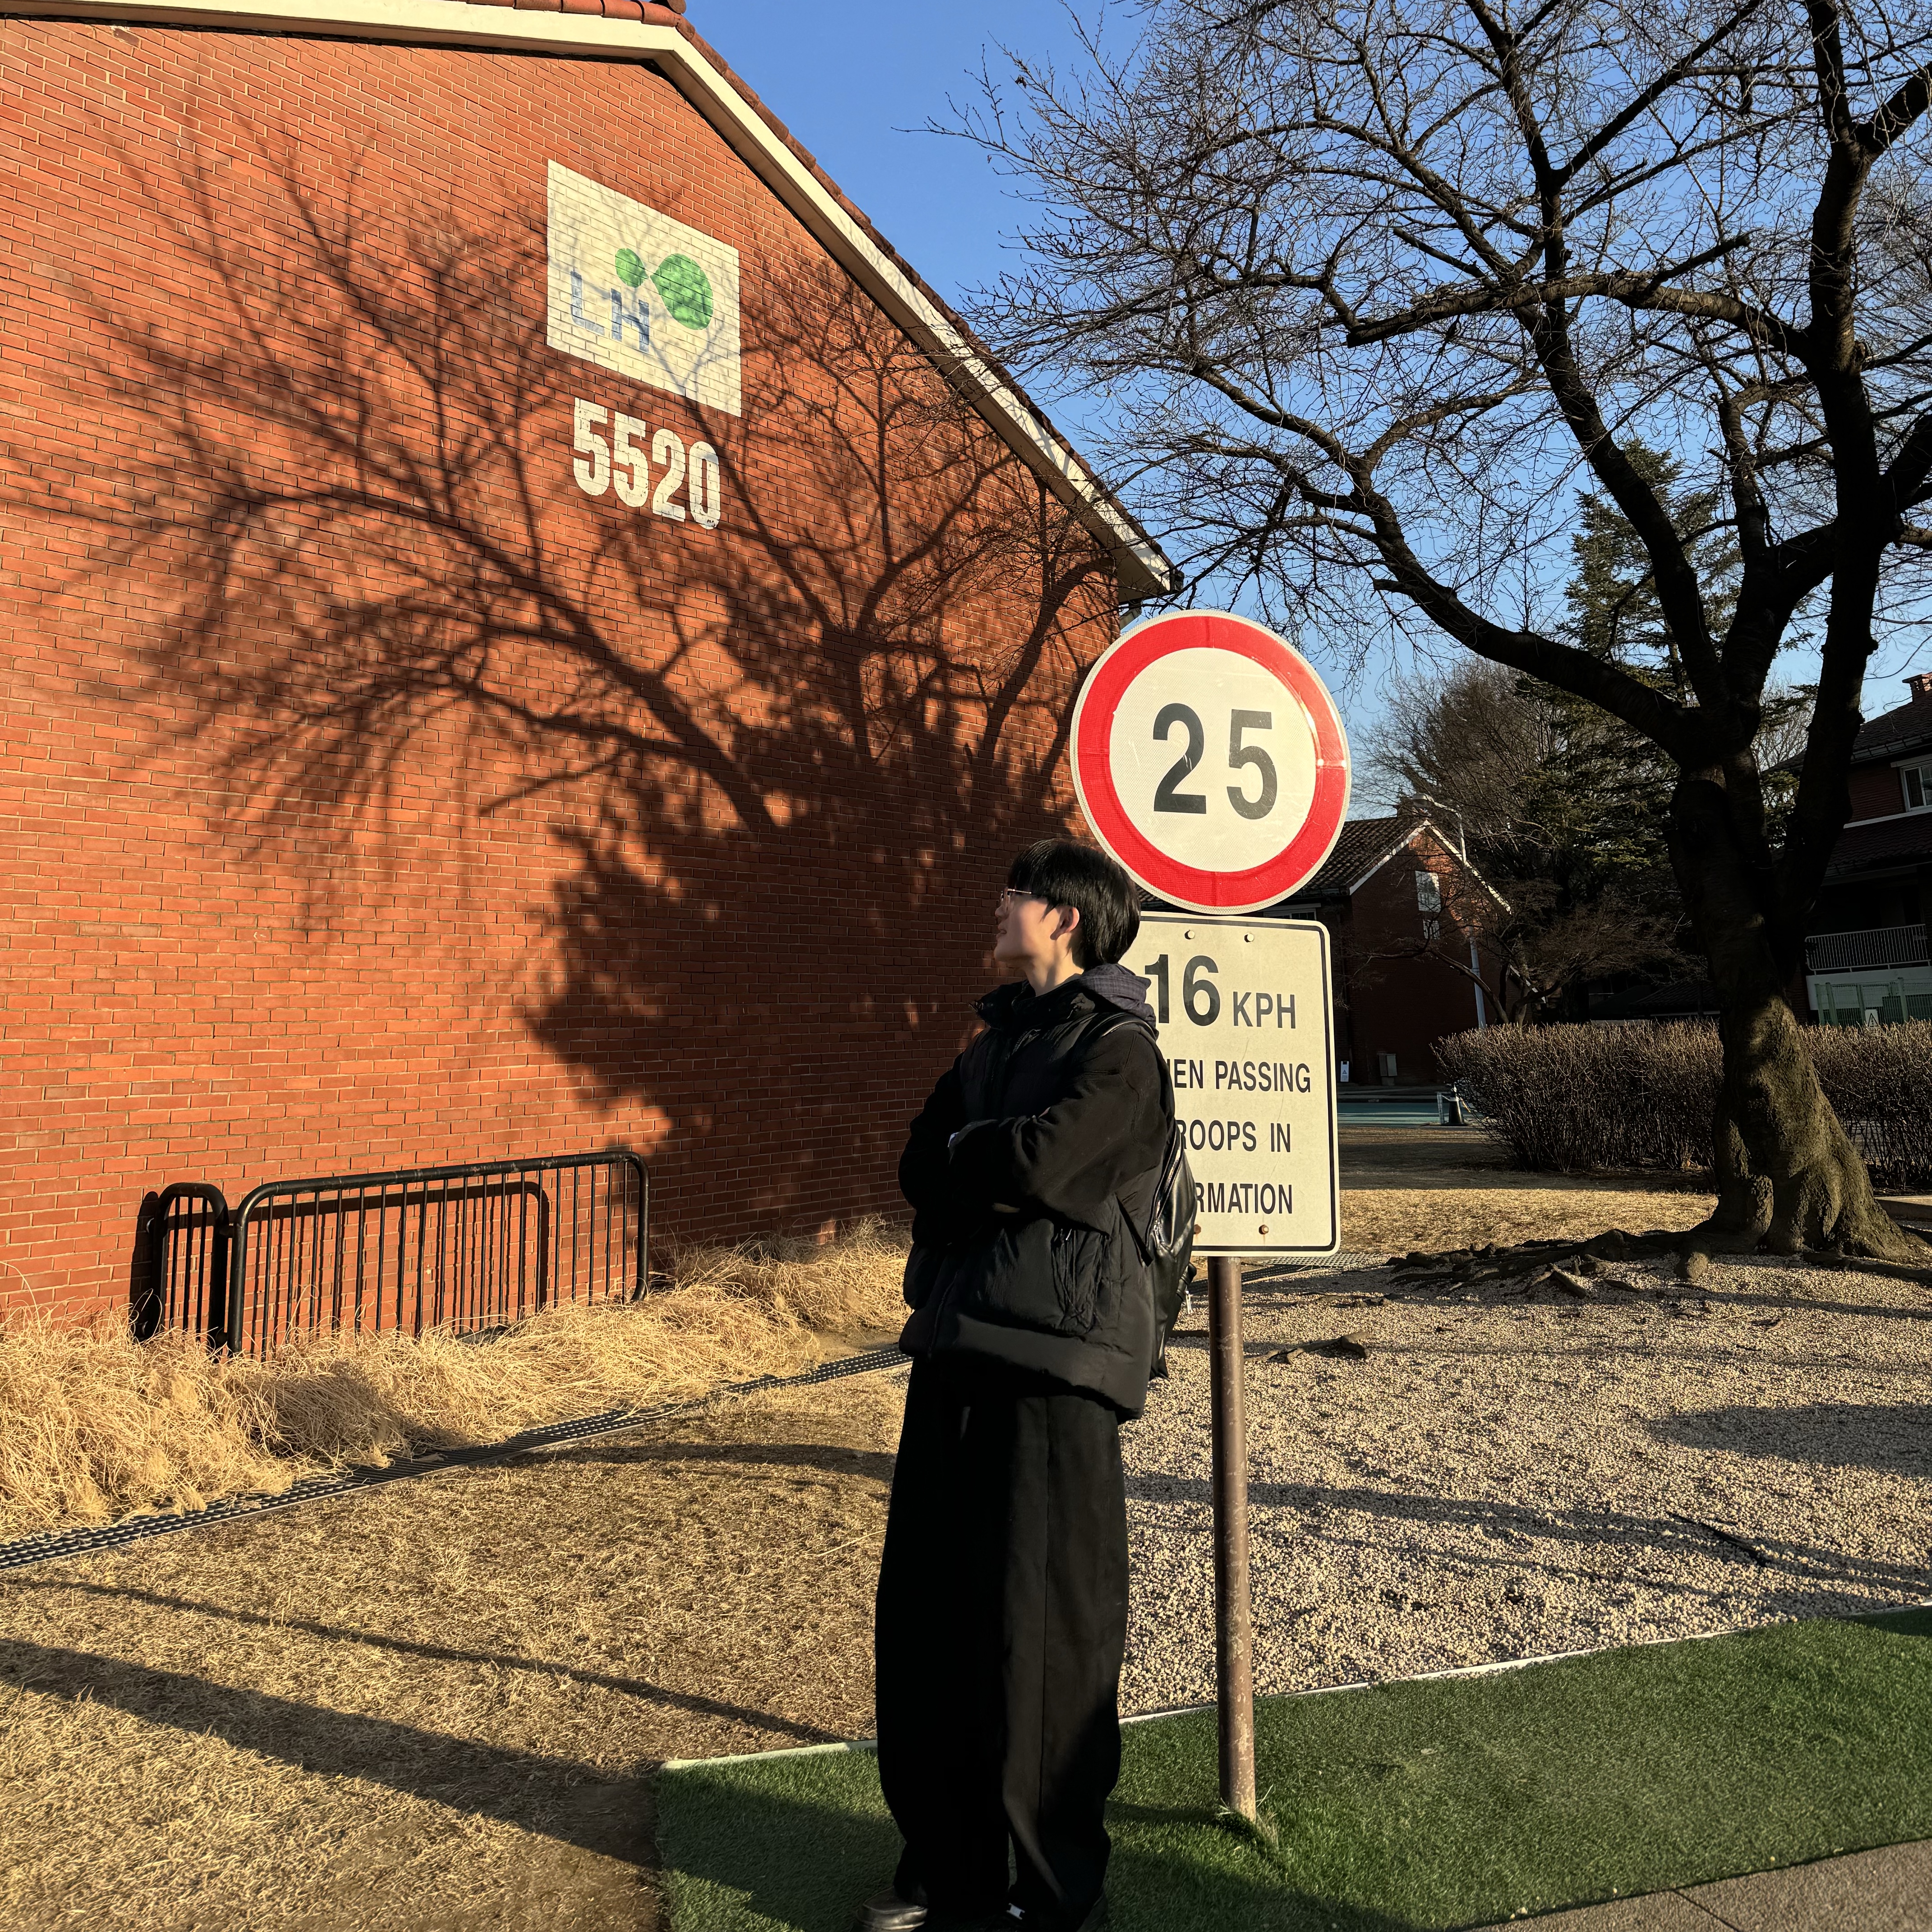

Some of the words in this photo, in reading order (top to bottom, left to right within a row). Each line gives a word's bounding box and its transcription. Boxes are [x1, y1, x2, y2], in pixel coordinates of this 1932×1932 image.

[570, 271, 650, 353] LH
[573, 397, 721, 530] 5520
[1153, 703, 1277, 820] 25
[1144, 954, 1221, 1026] 16
[1233, 991, 1296, 1029] KPH
[1167, 1058, 1203, 1089] EN
[1215, 1060, 1311, 1093] PASSING
[1176, 1119, 1257, 1152] ROOPS
[1270, 1122, 1291, 1153] IN
[1196, 1182, 1292, 1214] RMATION
